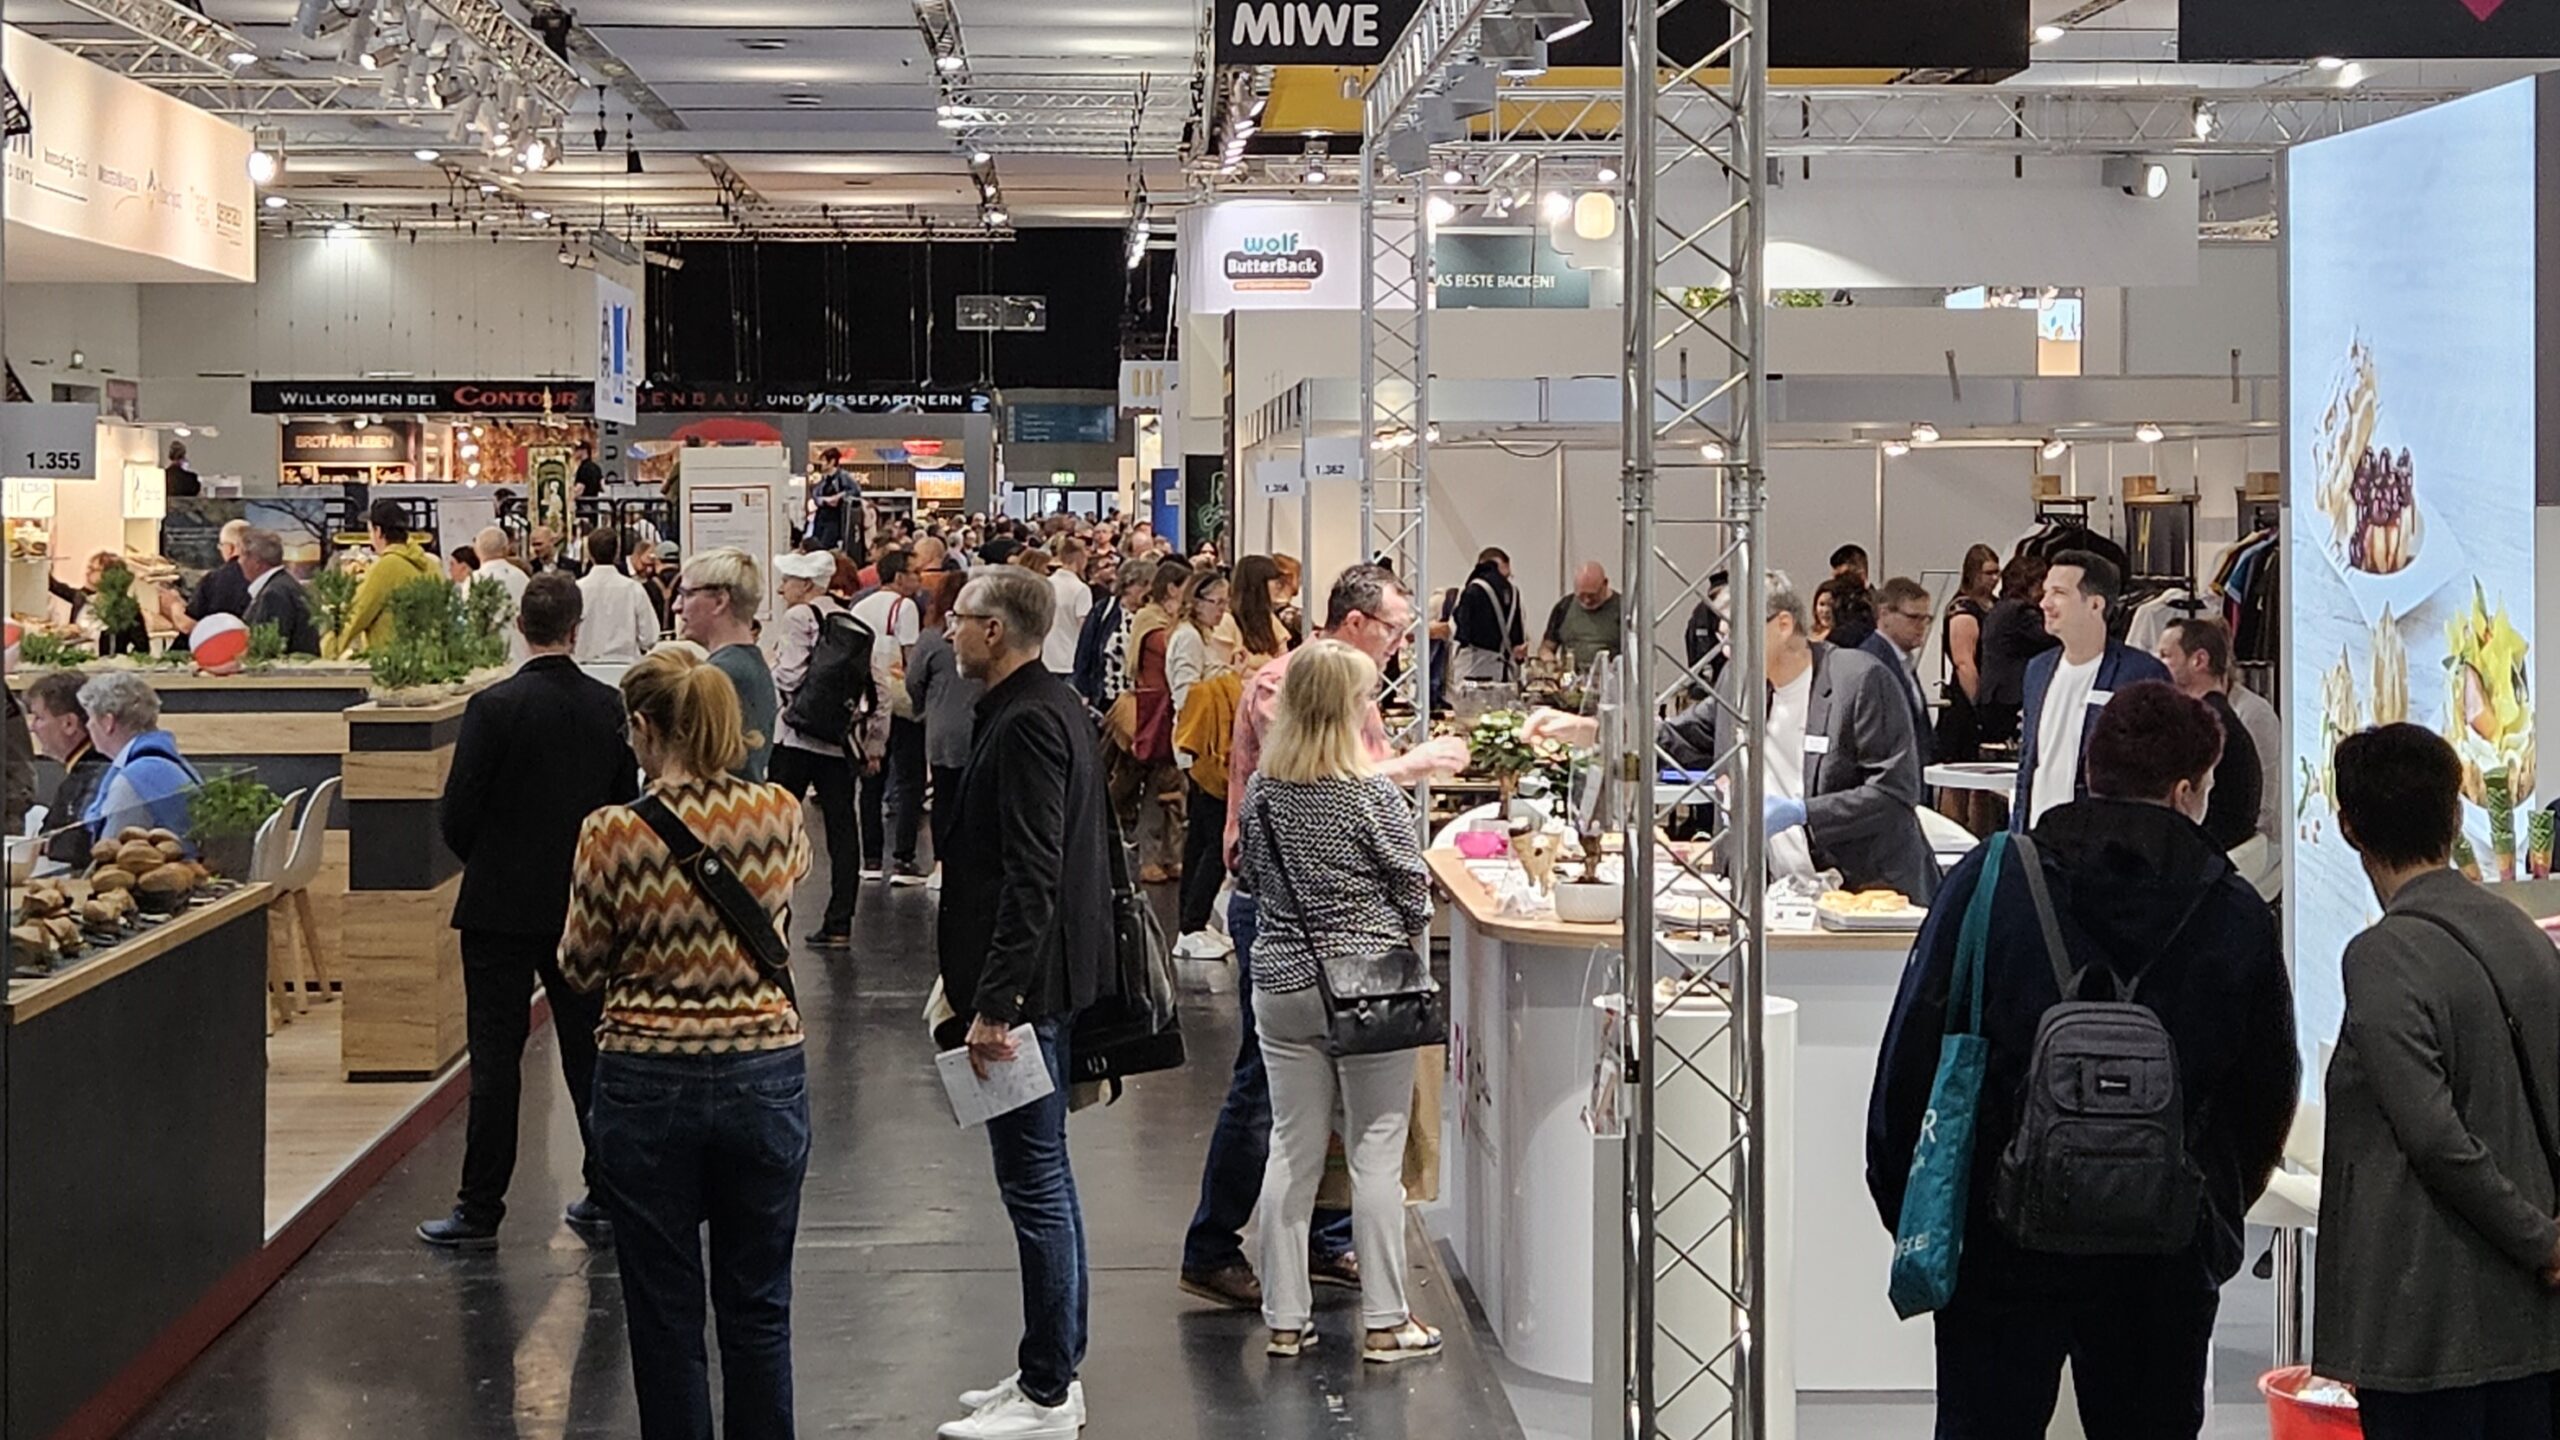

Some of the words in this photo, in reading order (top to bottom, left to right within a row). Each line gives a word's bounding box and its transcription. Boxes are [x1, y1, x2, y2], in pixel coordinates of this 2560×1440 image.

[1231, 2, 1379, 46] MIWE
[1244, 233, 1299, 252] wolf
[1227, 257, 1318, 274] ButterBack
[1435, 274, 1453, 288] AS
[1455, 274, 1494, 288] BESTE
[1498, 275, 1556, 289] BACKEN!
[280, 392, 402, 406] WILLKOMMEN
[407, 394, 436, 405] BEI
[767, 394, 804, 406] UND
[27, 452, 81, 470] 1.355
